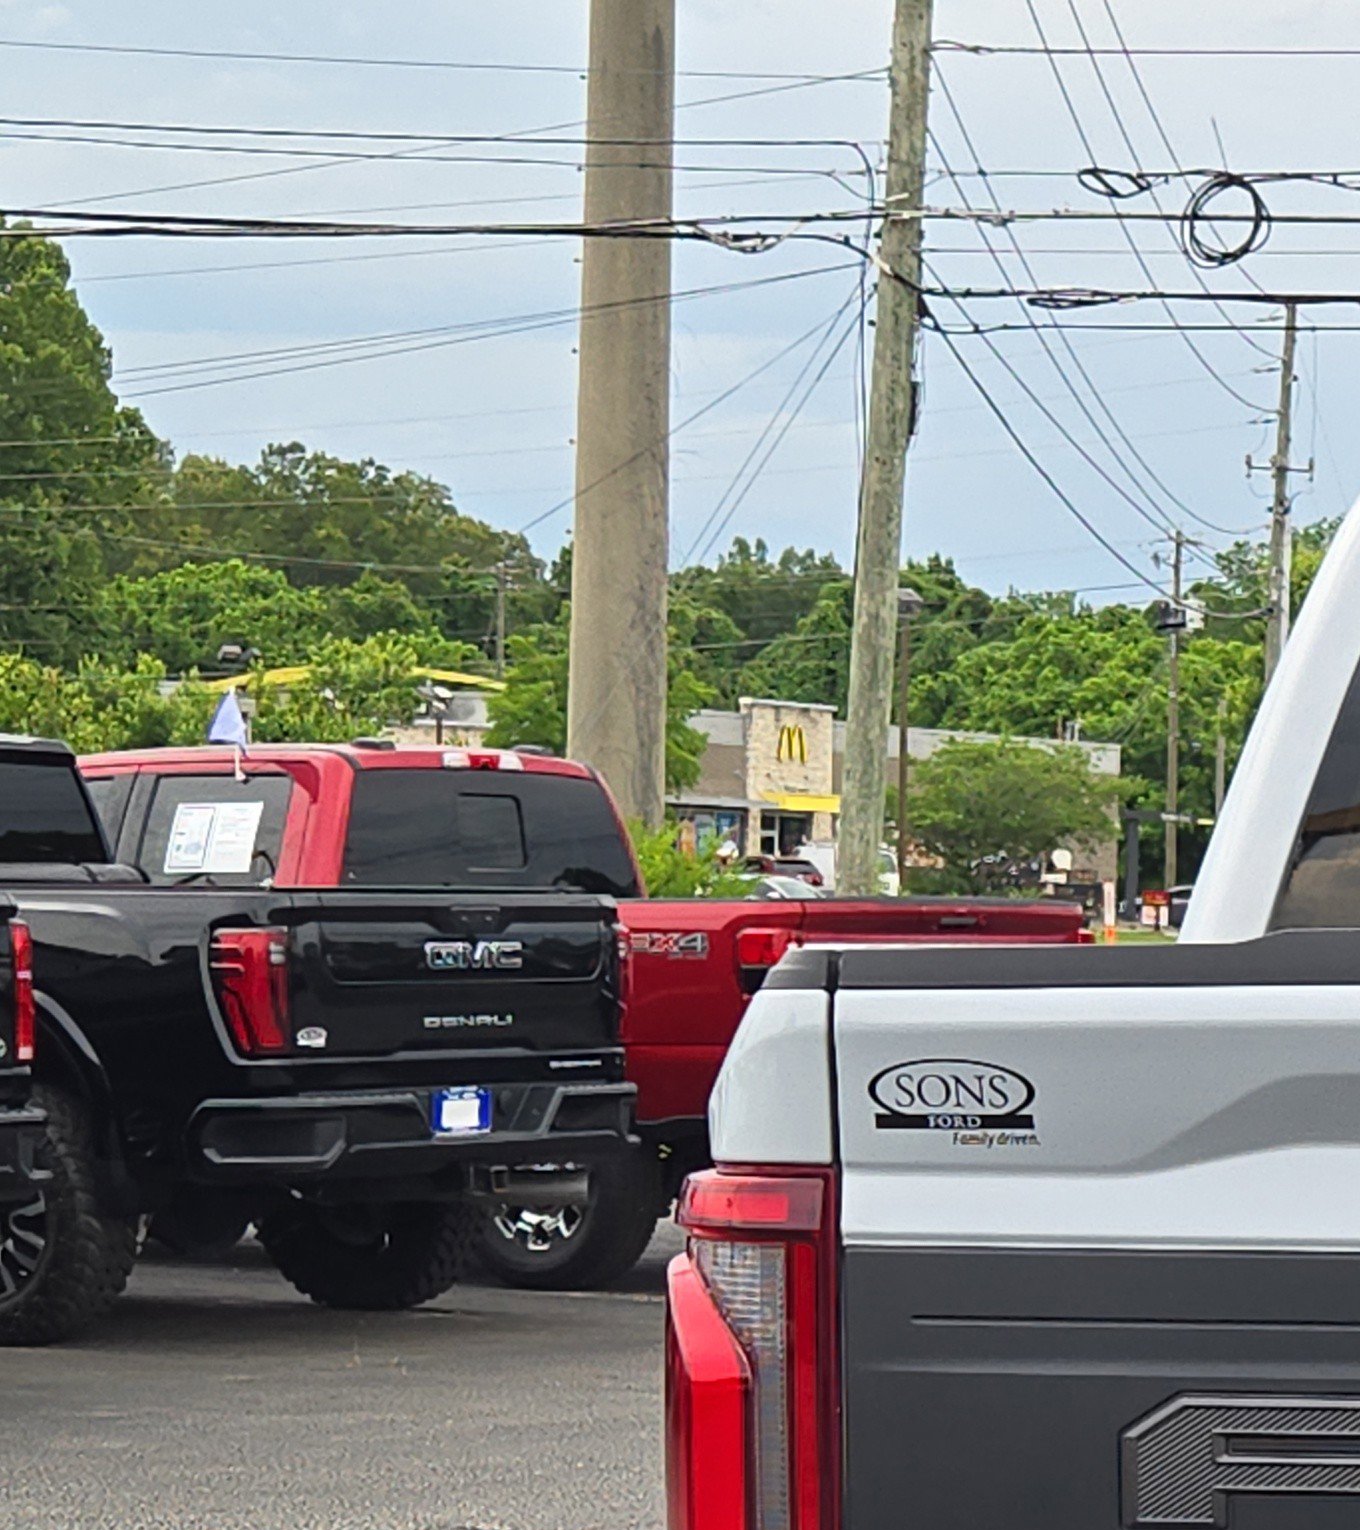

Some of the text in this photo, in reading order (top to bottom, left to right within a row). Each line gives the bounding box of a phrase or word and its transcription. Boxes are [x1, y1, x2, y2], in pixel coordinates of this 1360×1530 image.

[423, 941, 522, 970] GMC
[423, 1014, 513, 1028] DENALI
[895, 1073, 1010, 1109] SONS
[927, 1115, 982, 1128] FORD
[952, 1131, 995, 1149] Family
